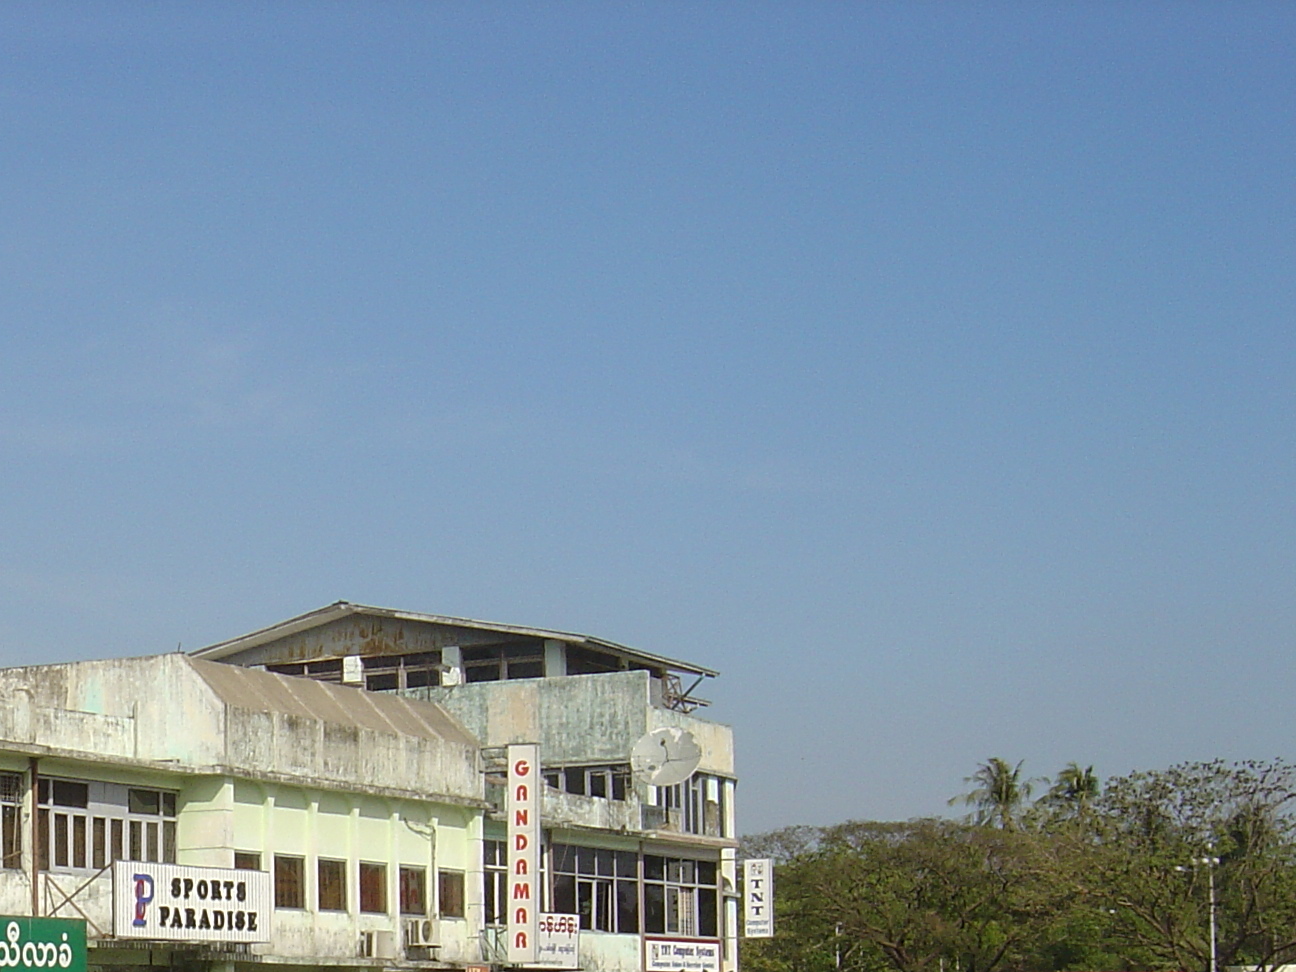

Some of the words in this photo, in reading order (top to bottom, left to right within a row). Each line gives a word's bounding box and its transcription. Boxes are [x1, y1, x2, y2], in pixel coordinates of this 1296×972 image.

[513, 760, 530, 949] GANDAMAR
[171, 878, 247, 902] SPORTS
[750, 879, 764, 916] TNT
[159, 906, 258, 932] PARADISE
